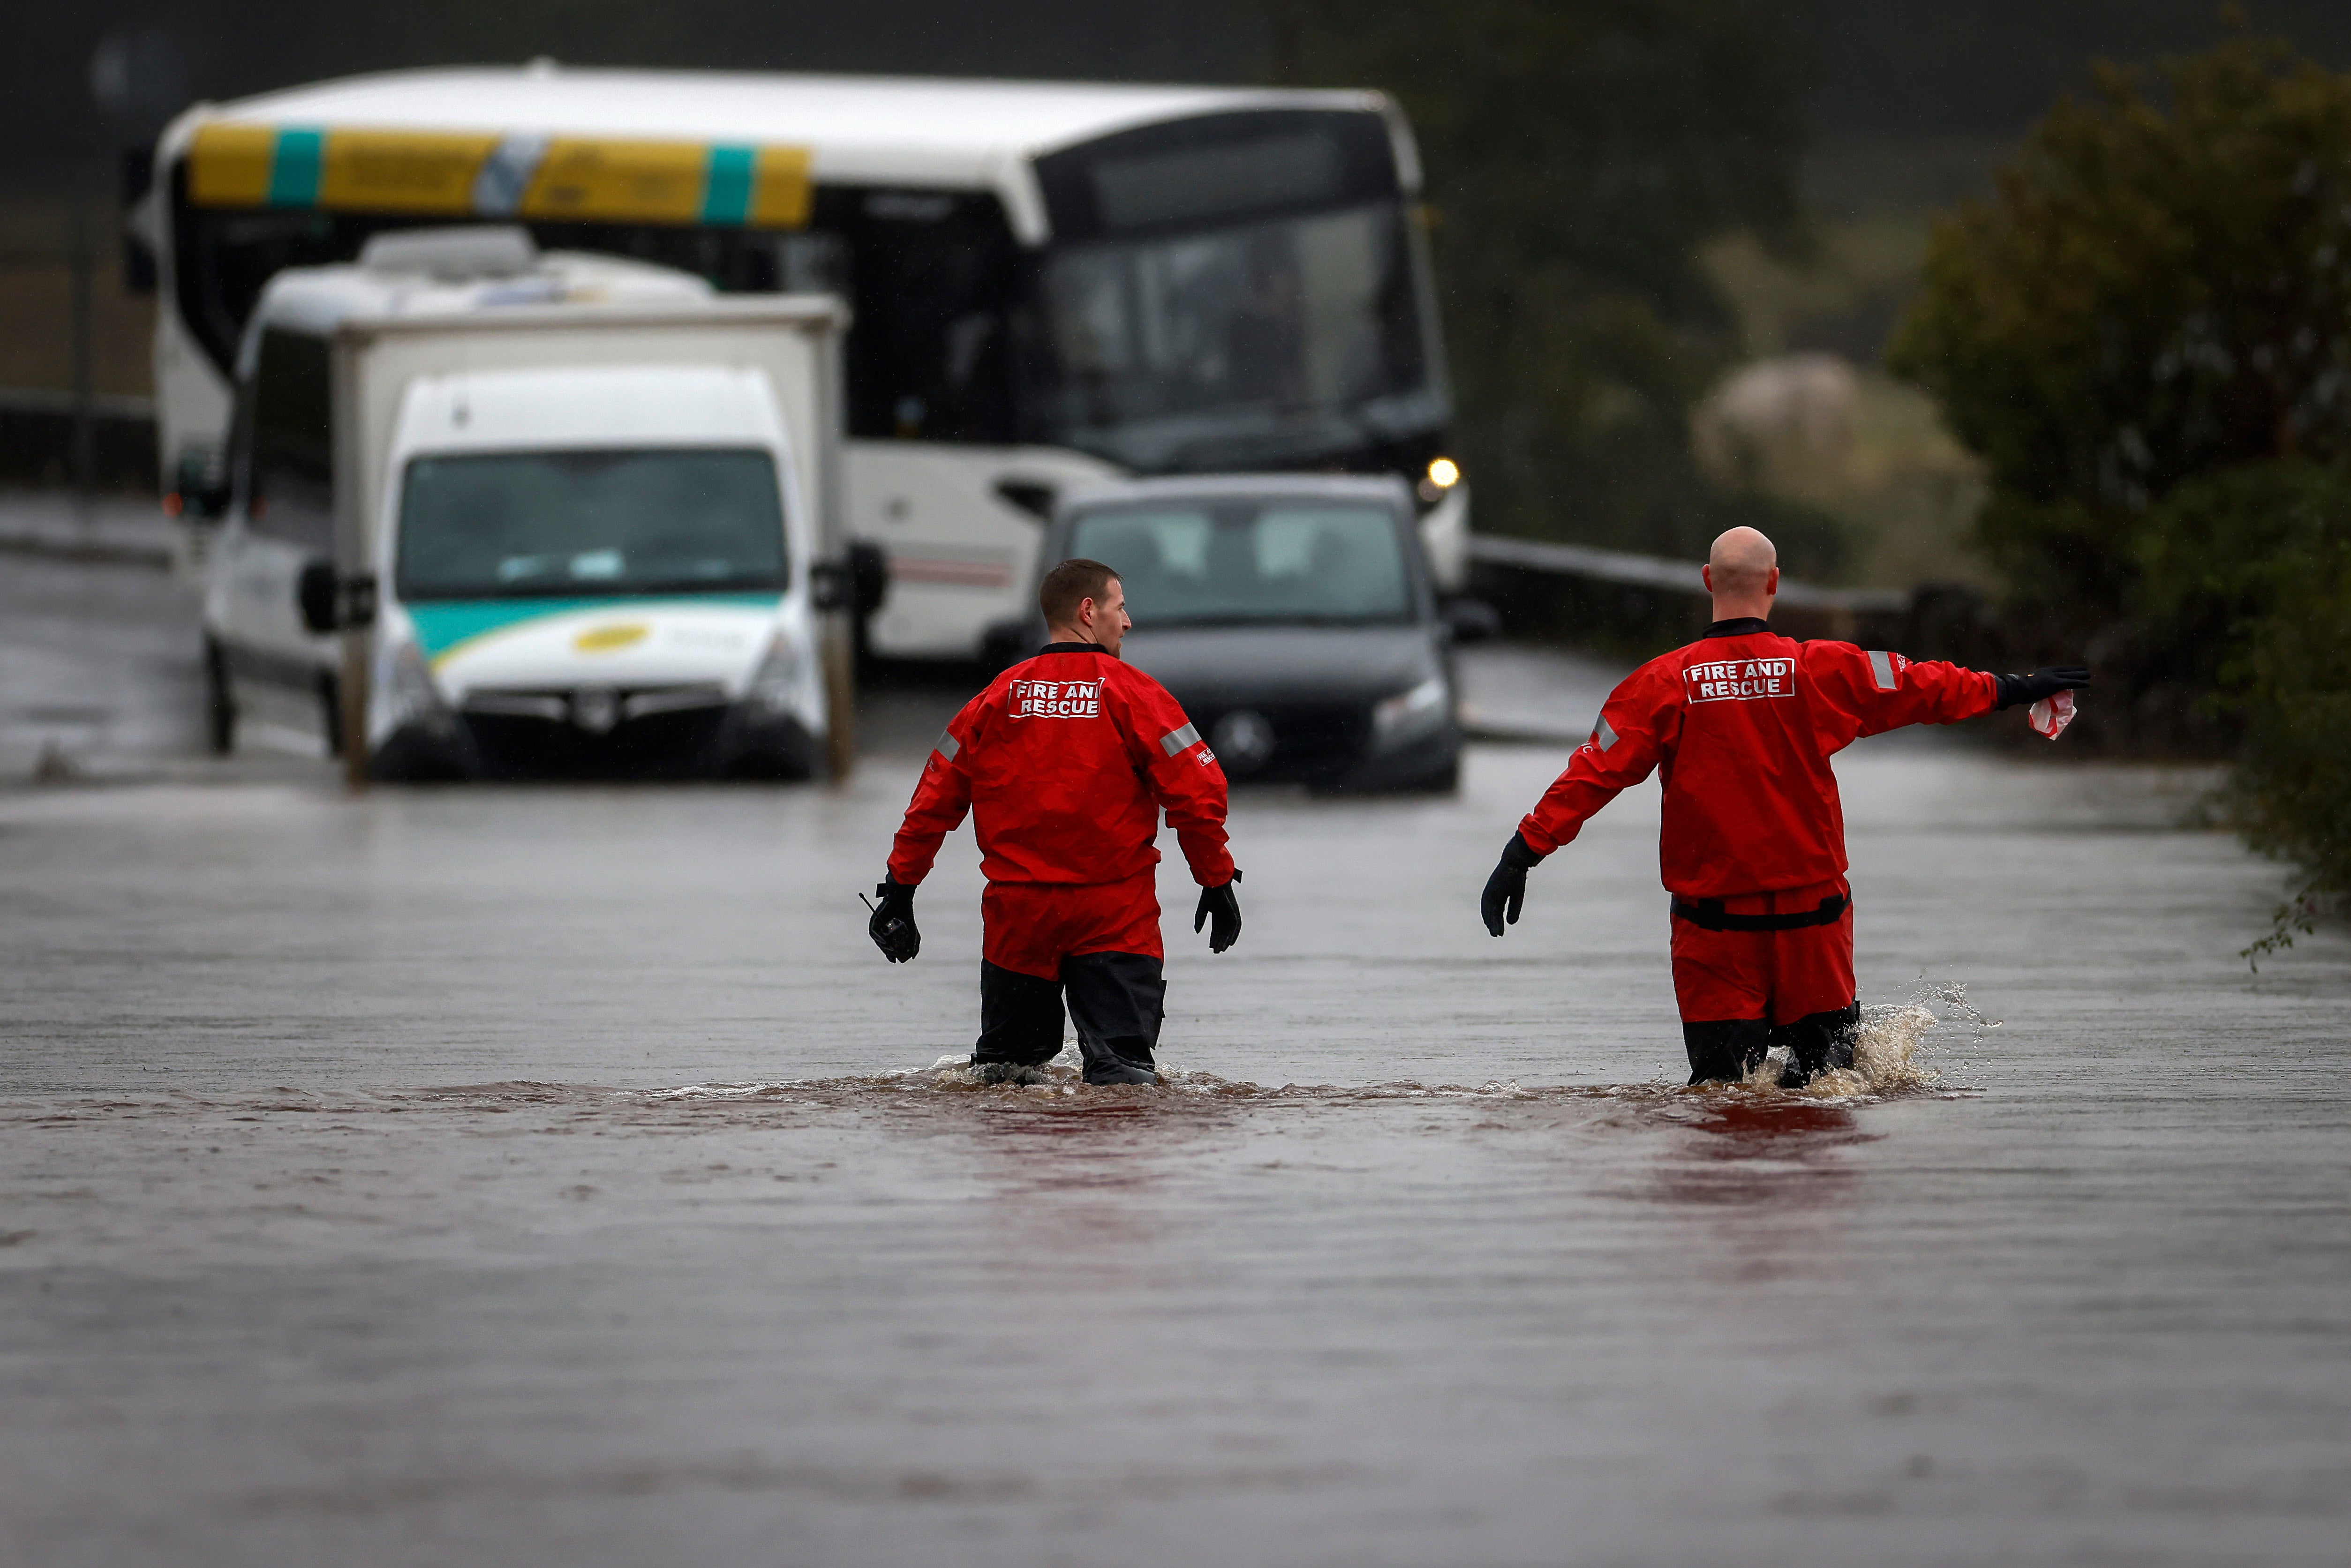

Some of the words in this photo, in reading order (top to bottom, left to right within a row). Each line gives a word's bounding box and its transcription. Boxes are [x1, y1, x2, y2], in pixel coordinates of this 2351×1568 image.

[1691, 665, 1738, 682] FIRE
[1744, 662, 1786, 678] AND
[1016, 683, 1059, 699] FIRE
[1701, 678, 1780, 697] RESCUE
[1021, 699, 1098, 714] RESCUE
